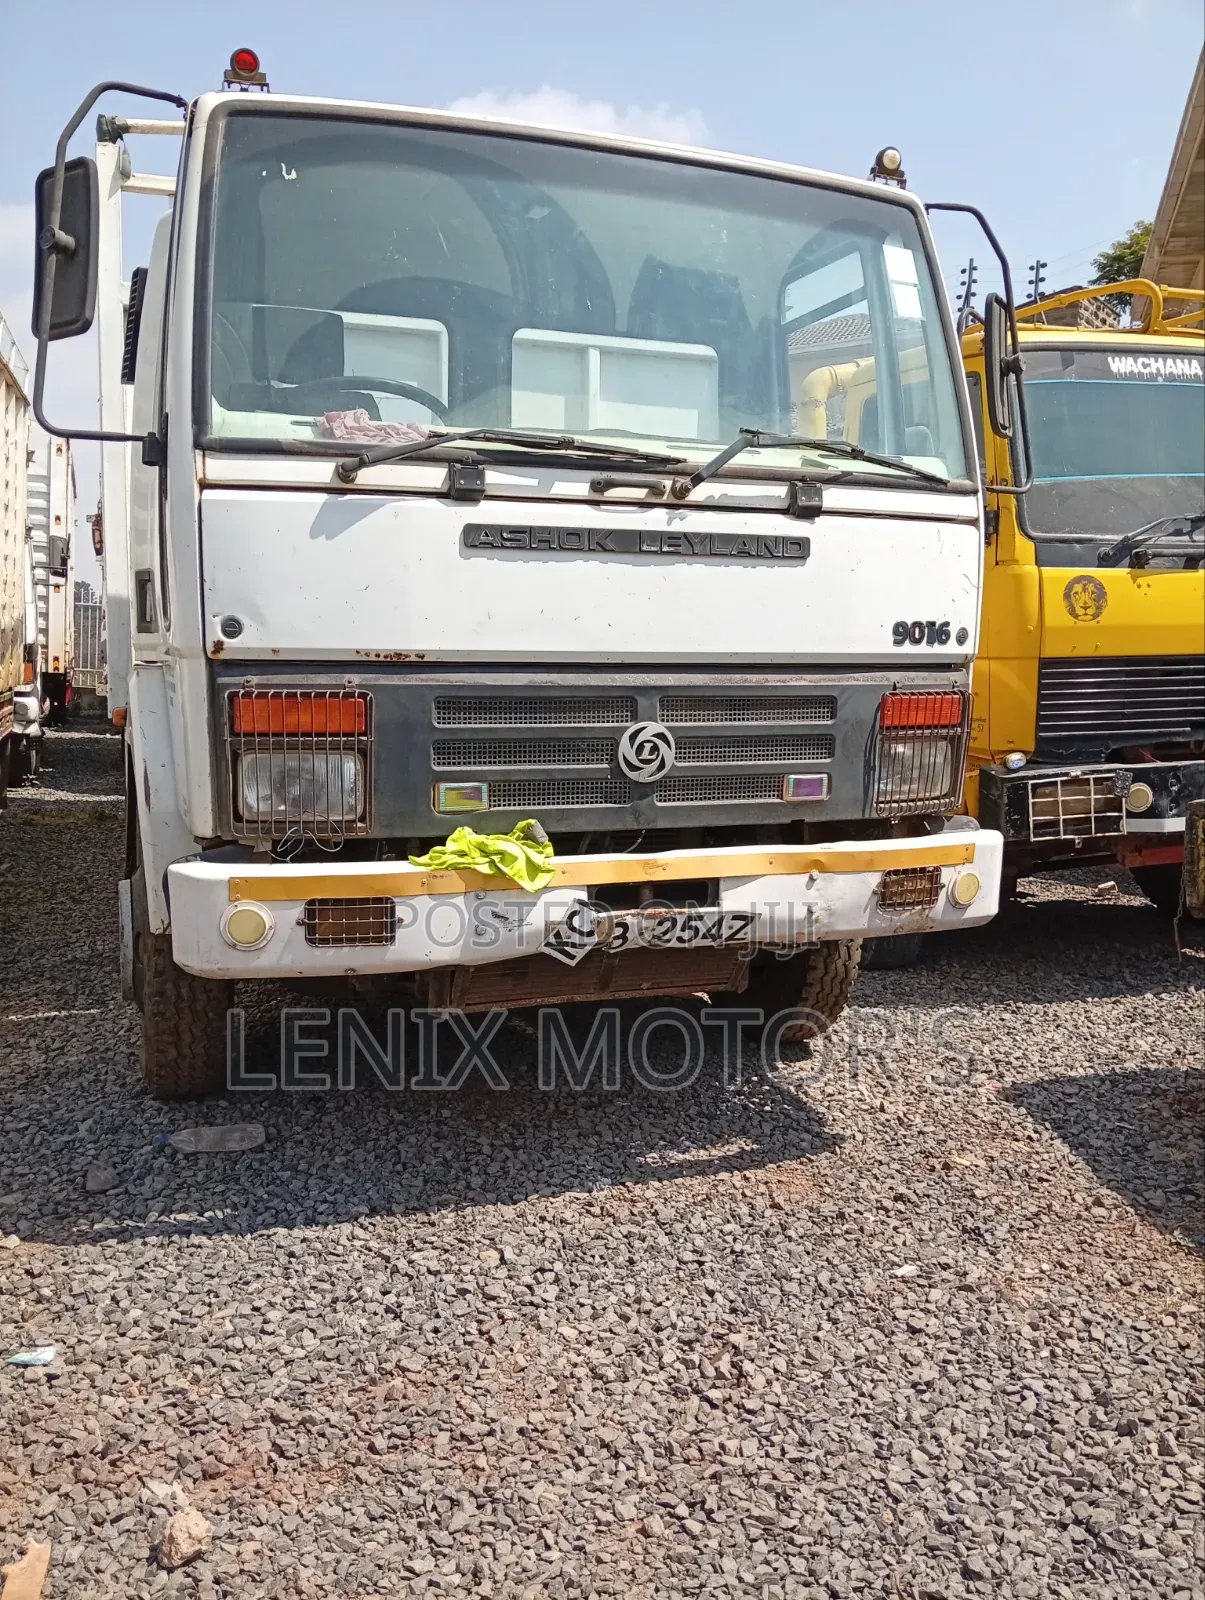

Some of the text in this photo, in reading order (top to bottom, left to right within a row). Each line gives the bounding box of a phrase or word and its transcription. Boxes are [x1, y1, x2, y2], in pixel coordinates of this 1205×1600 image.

[1107, 356, 1203, 380] WACHANA
[473, 527, 808, 558] ASHOK LEYLAND
[892, 620, 951, 646] 9016
